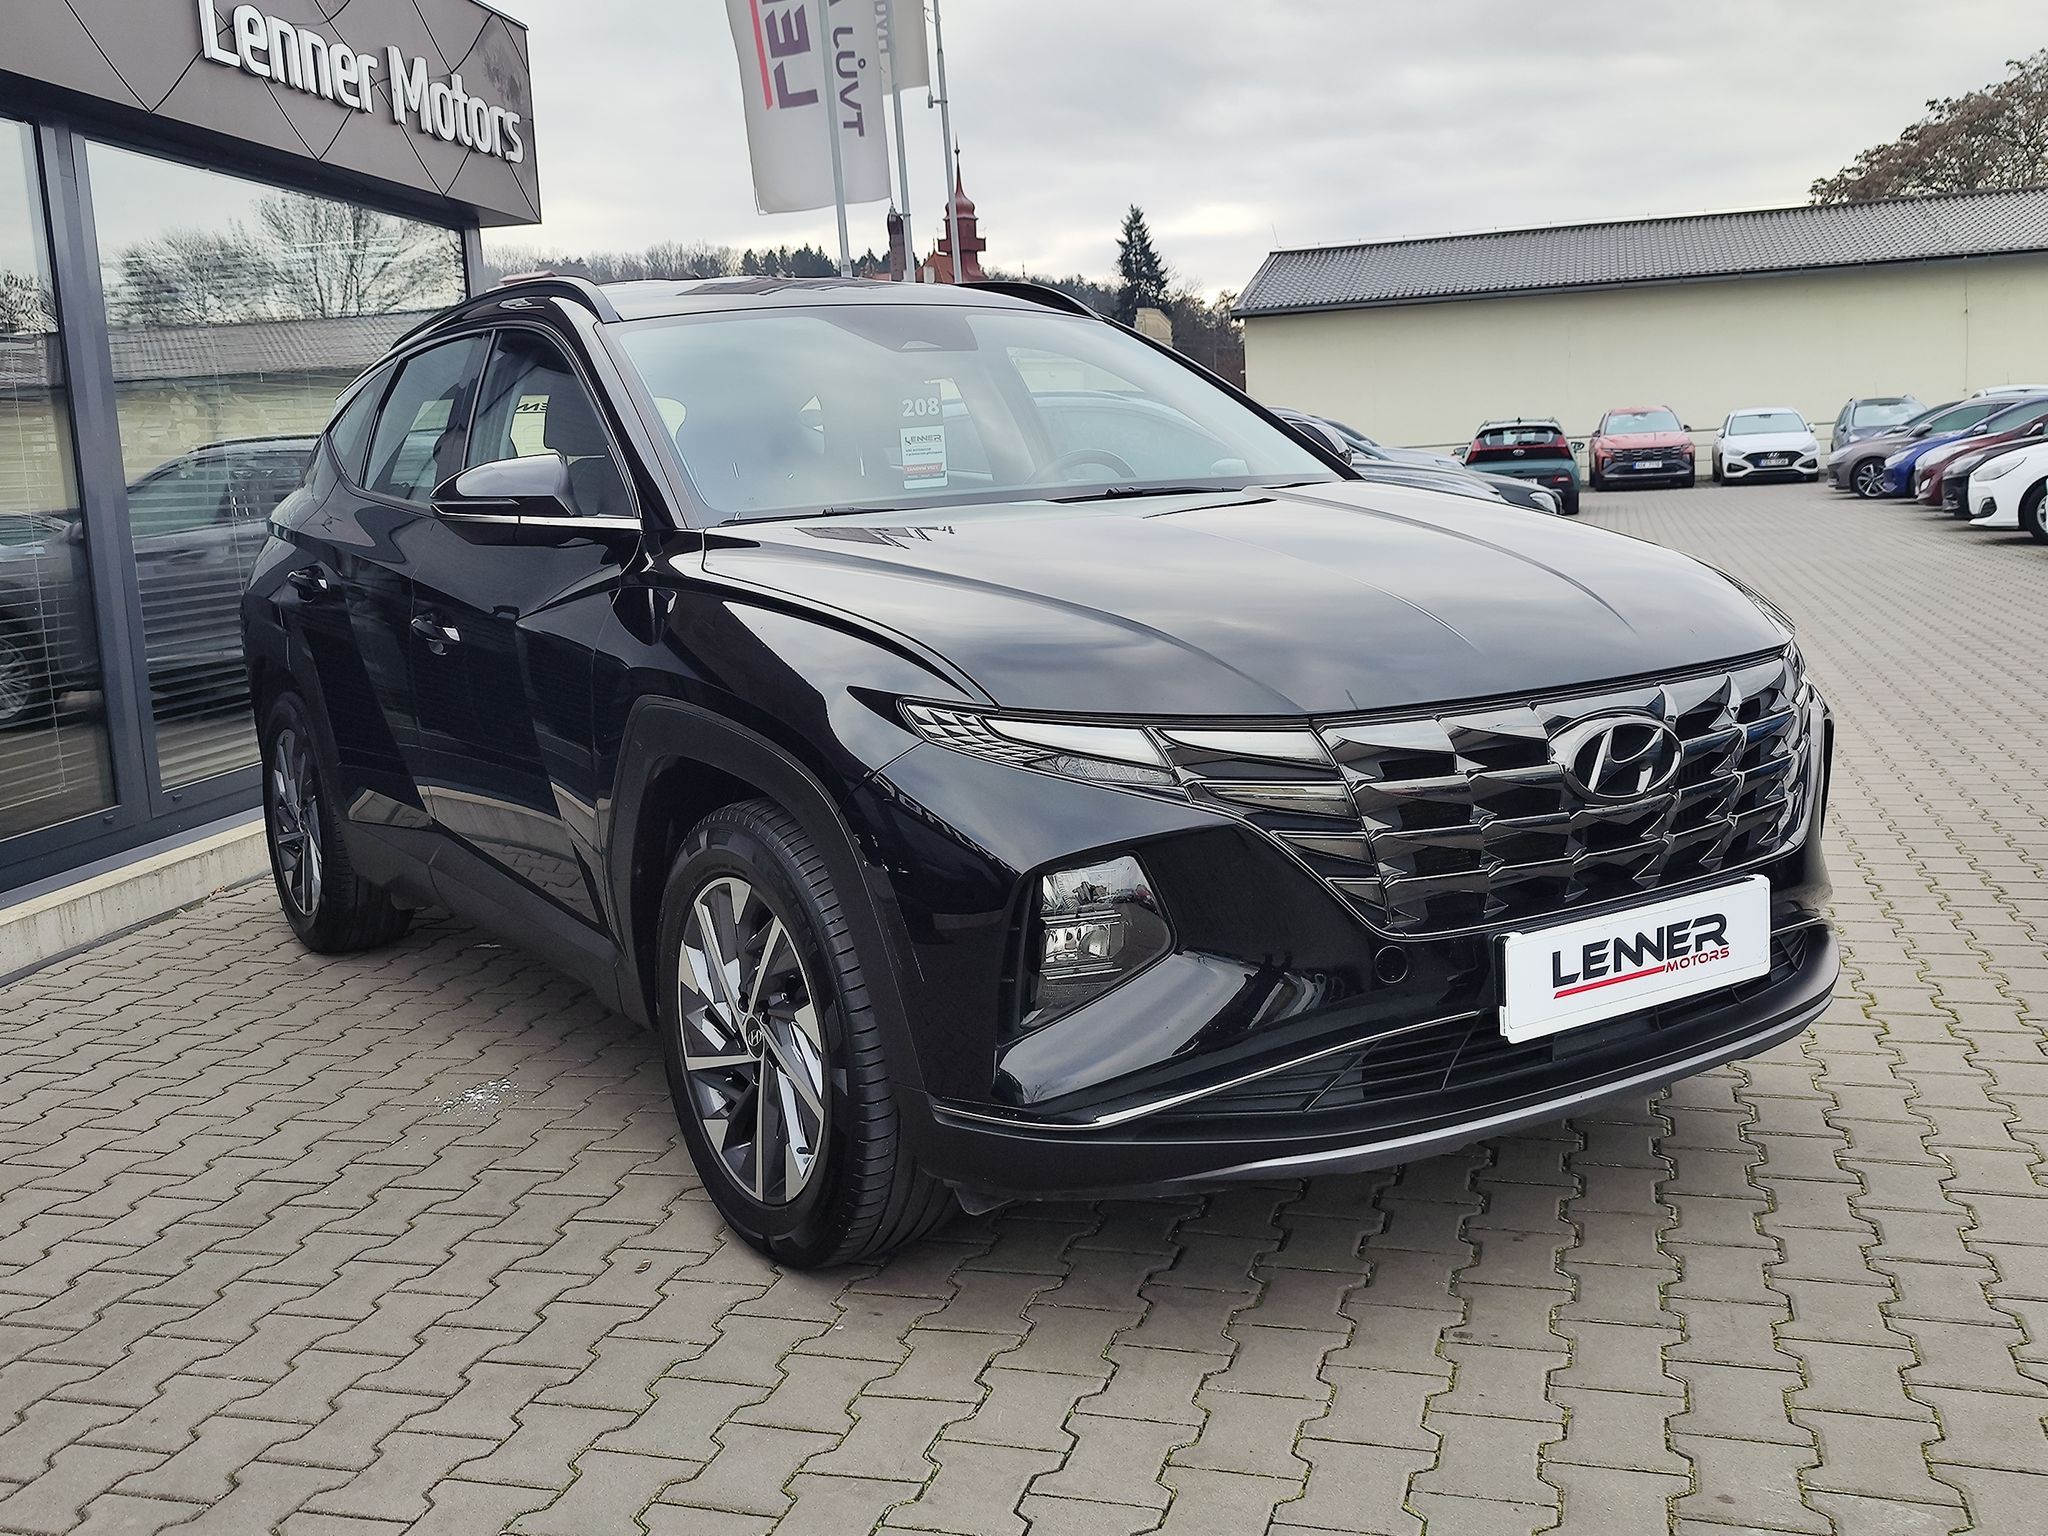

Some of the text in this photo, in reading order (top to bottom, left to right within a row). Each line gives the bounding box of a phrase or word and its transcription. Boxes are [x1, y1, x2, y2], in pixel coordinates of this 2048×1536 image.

[198, 0, 525, 163] Lenner Motors
[902, 398, 940, 417] 208
[1552, 913, 1729, 988] LENNER
[1665, 946, 1730, 973] MOTORS
